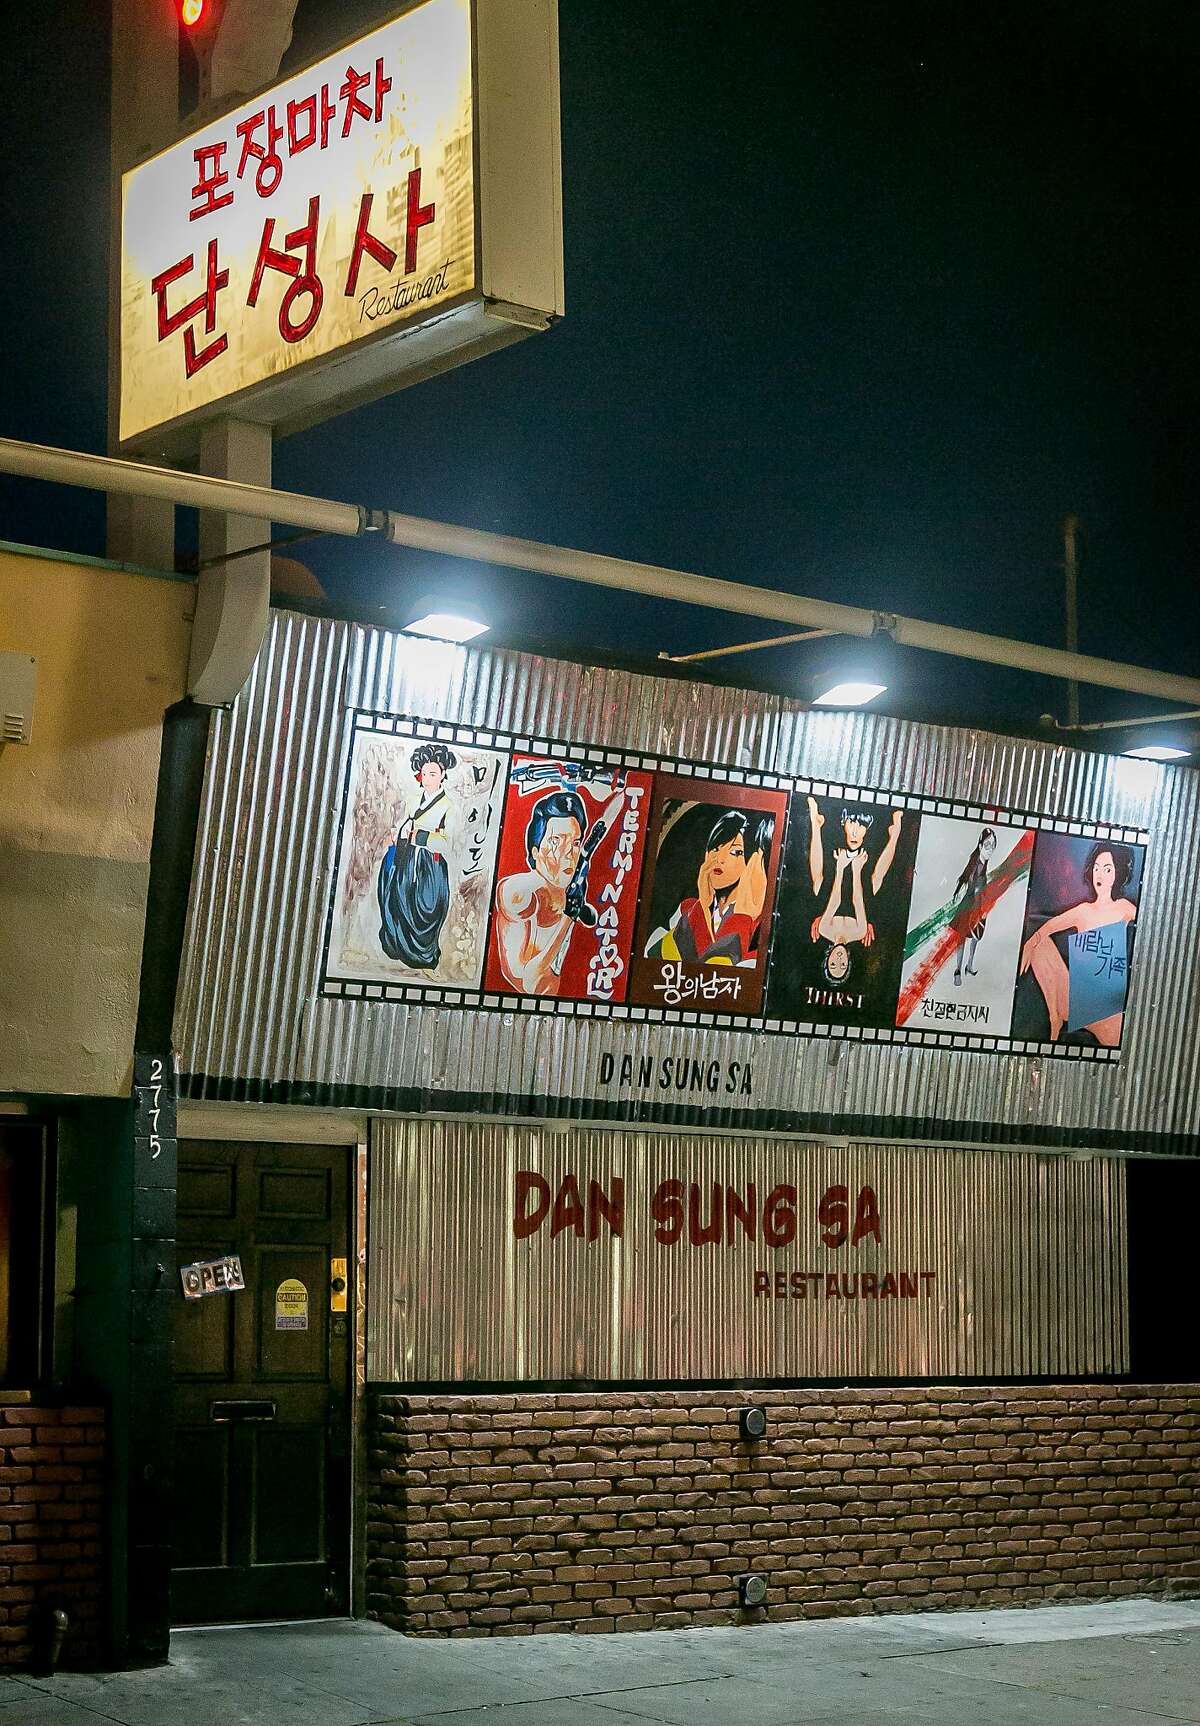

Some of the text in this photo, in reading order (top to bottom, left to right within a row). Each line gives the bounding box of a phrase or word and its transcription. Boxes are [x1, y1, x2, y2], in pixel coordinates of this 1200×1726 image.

[188, 57, 392, 222] 포장마차
[151, 168, 435, 380] 단성사
[359, 258, 456, 324] Restaurant
[462, 759, 501, 876] 미인도
[587, 786, 644, 999] TERMINATOR
[653, 961, 742, 1005] 왕의남자
[804, 986, 865, 1009] THIRST
[149, 1059, 163, 1159] 2775
[600, 1052, 752, 1095] DAN SUNG SA
[513, 1171, 882, 1249] DAN SUNG SA
[185, 1259, 241, 1293] OPEN
[754, 1271, 937, 1300] RESTAURANT
